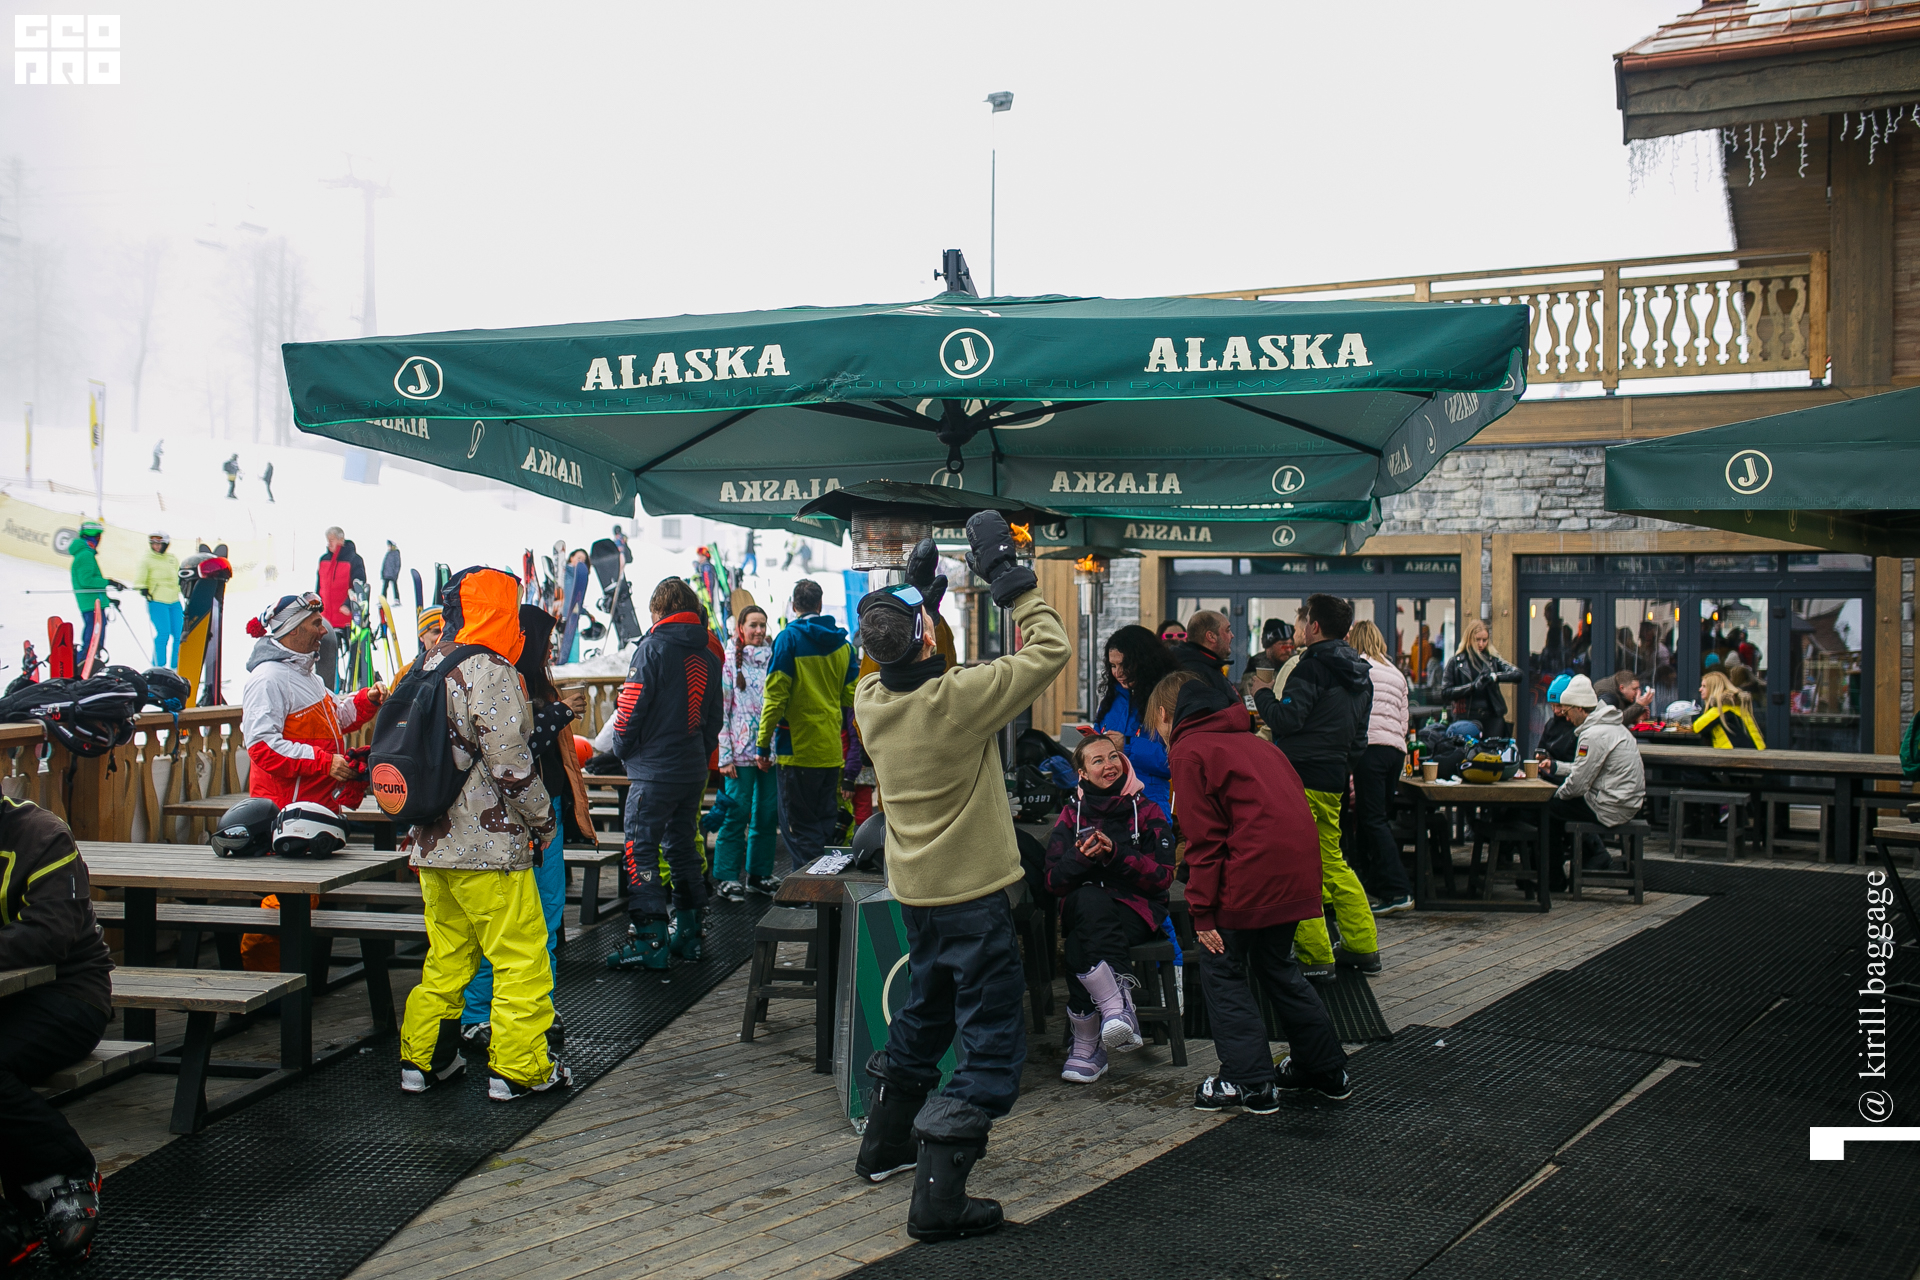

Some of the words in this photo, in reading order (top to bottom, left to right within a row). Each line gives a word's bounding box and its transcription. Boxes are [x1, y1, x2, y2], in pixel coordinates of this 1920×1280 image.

[581, 344, 790, 391] ALASKA
[1144, 333, 1373, 373] ALASKA
[978, 379, 1118, 390] ВРЕДИТ
[1130, 378, 1288, 391] ВАШЕМУ
